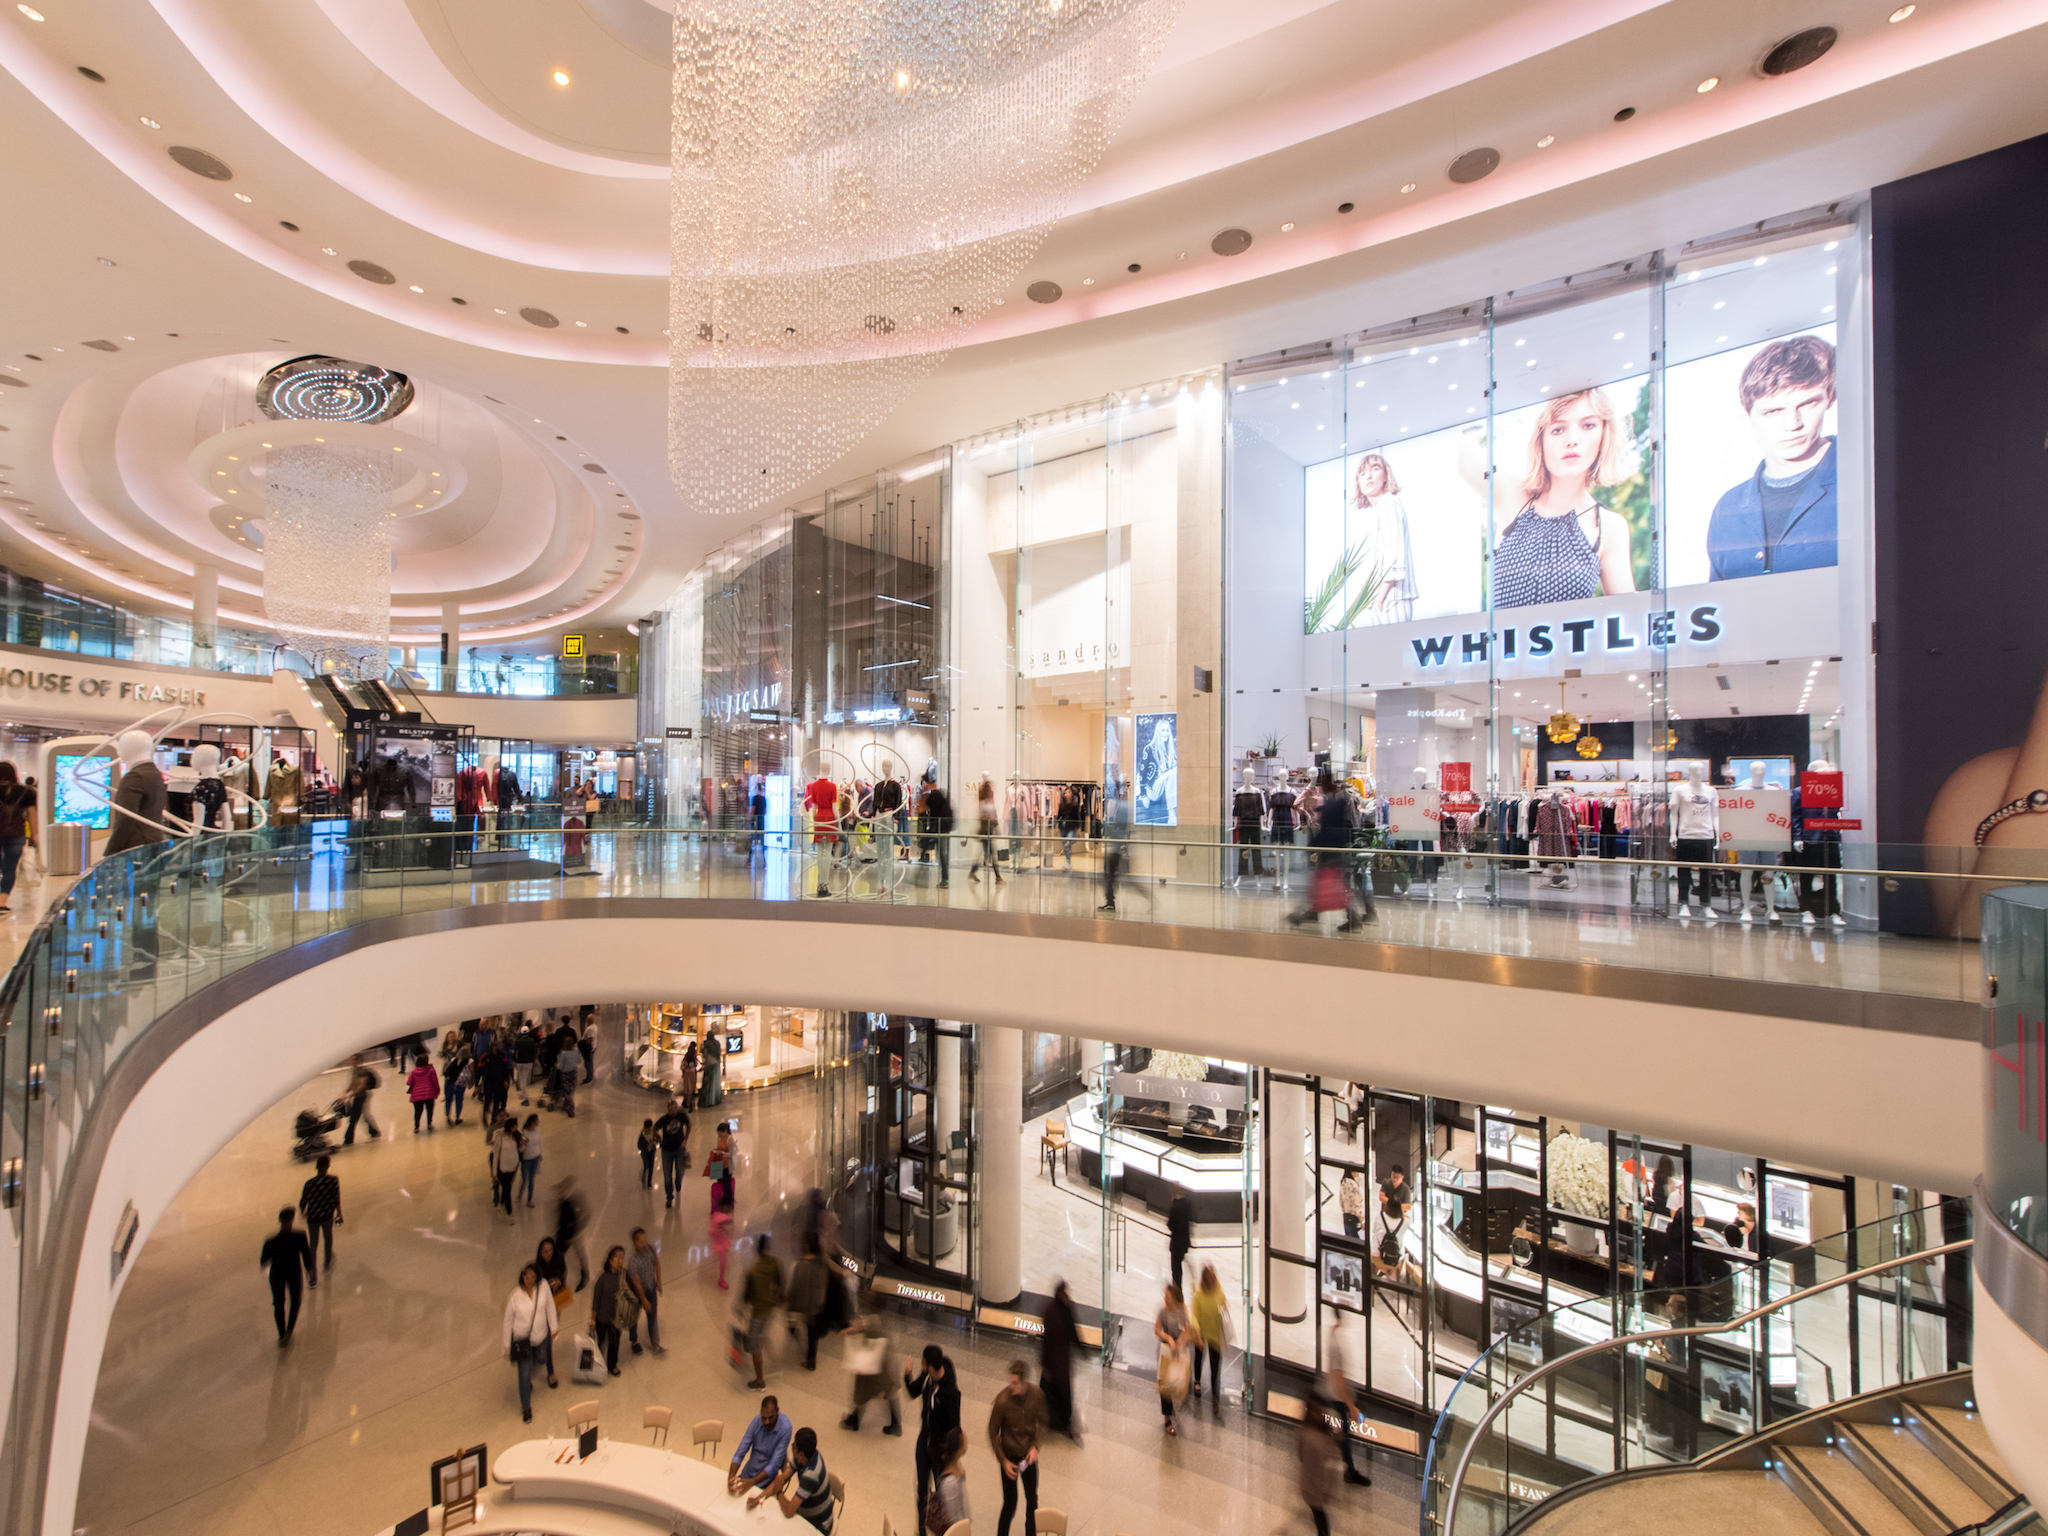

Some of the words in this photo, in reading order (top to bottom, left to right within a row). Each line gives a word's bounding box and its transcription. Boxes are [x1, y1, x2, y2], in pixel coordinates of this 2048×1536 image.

[1411, 606, 1721, 667] WHISTLES
[1030, 642, 1118, 665] sandro
[79, 678, 112, 697] OF
[120, 681, 206, 706] FRASER
[725, 681, 782, 723] JIGSAW
[908, 696, 931, 705] sandro
[398, 728, 435, 736] BELSTAFF
[1445, 771, 1467, 781] 70%
[1806, 783, 1838, 795] 70%
[1388, 795, 1416, 806] sale
[1718, 796, 1755, 809] sale
